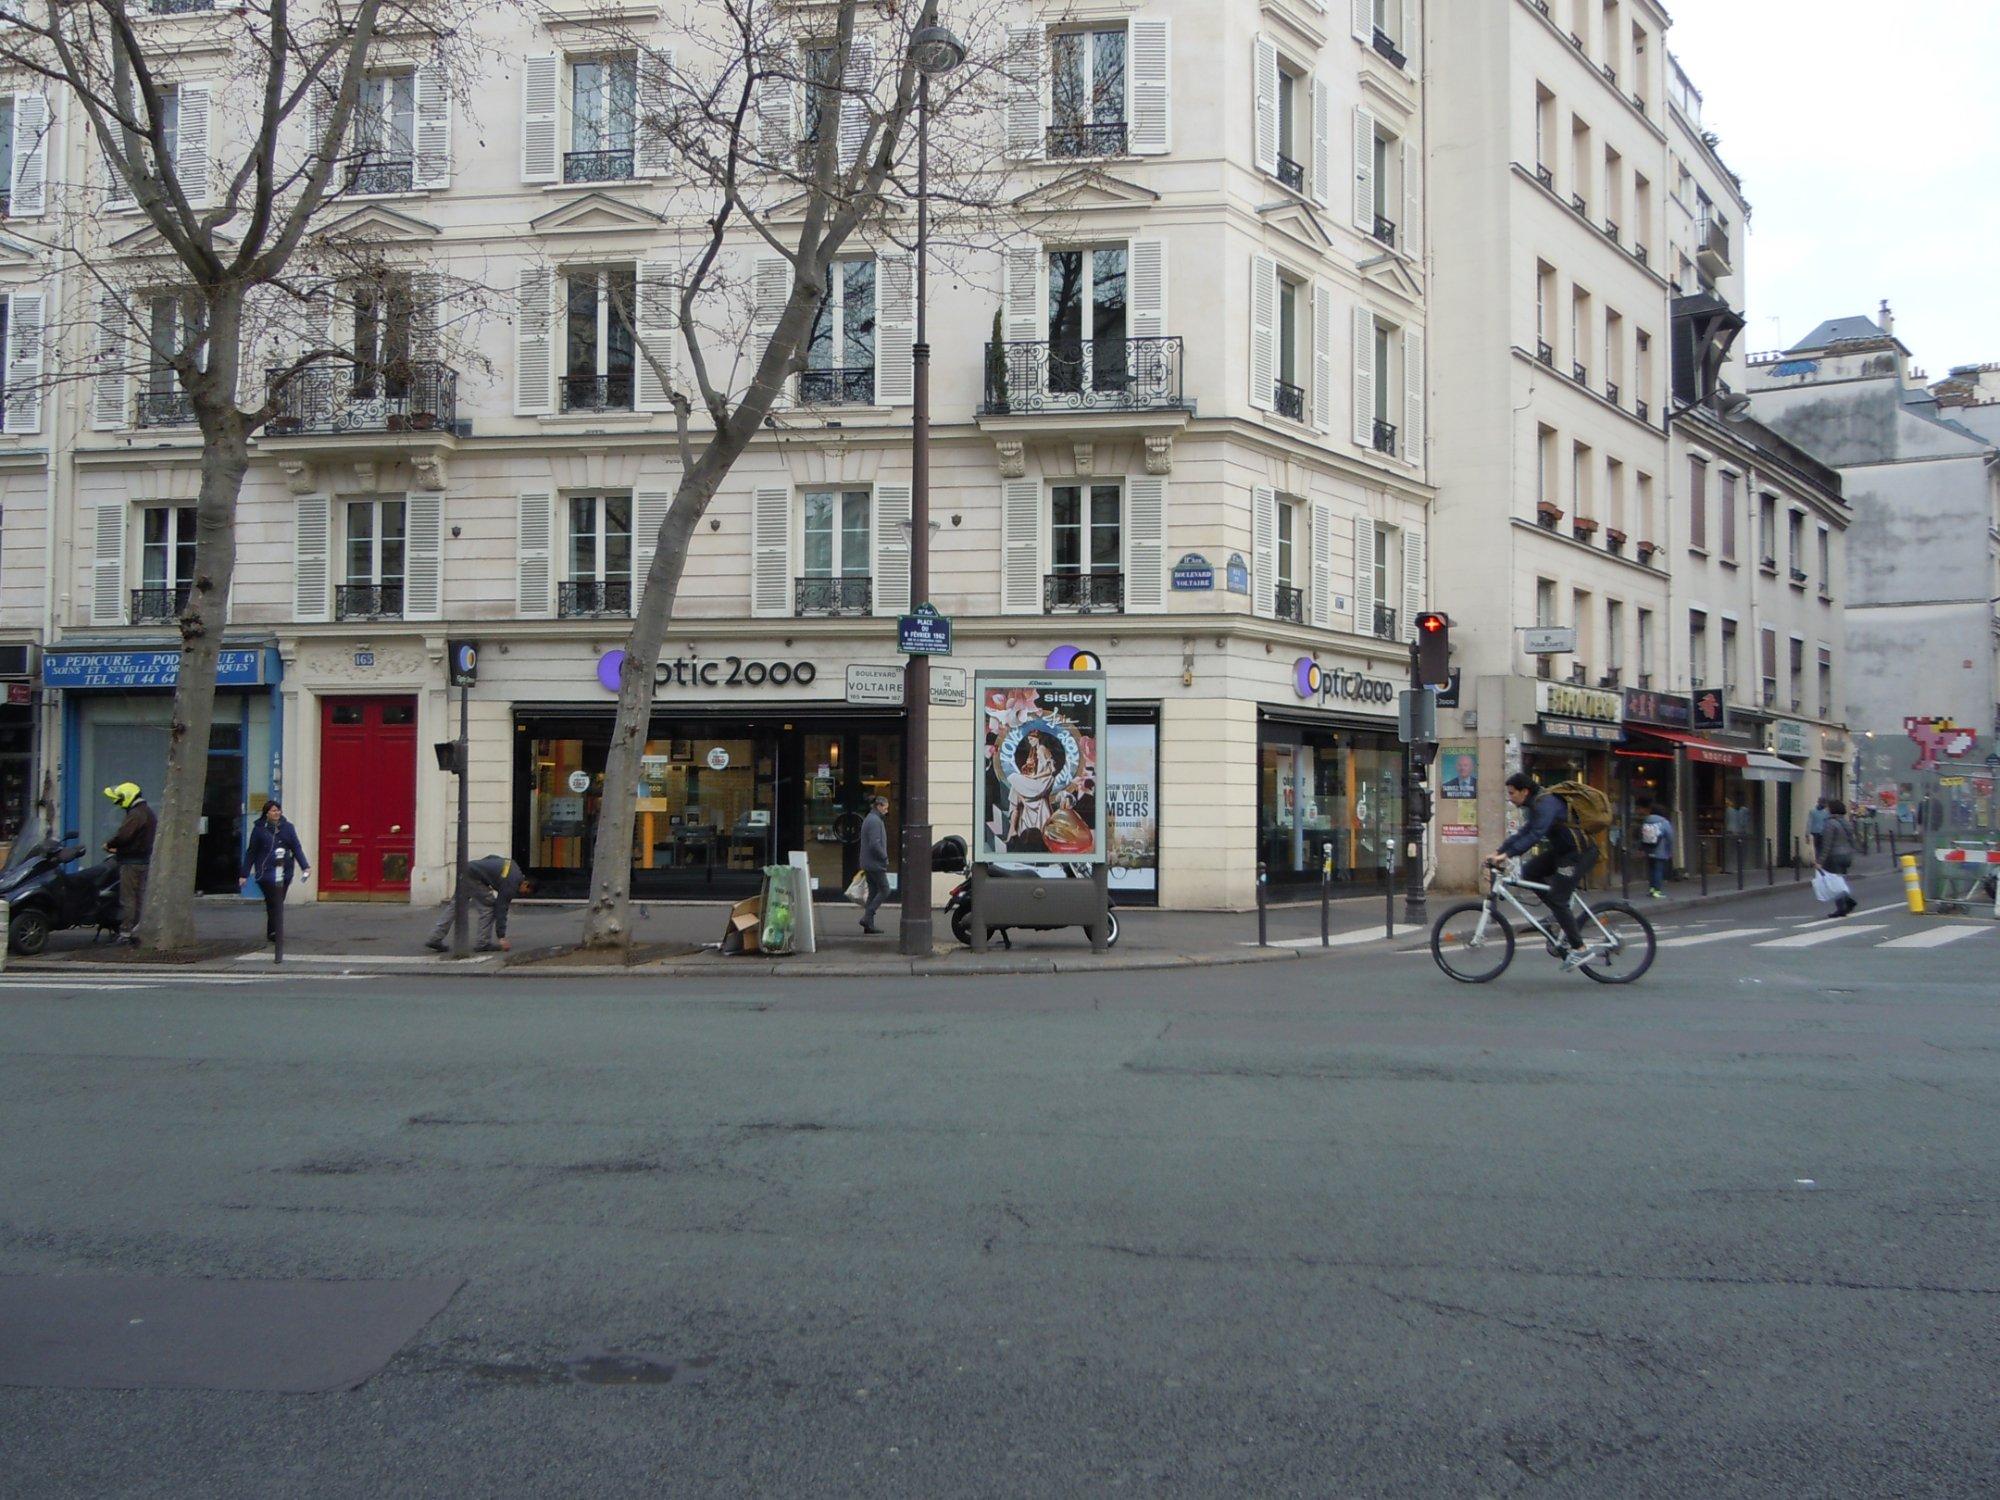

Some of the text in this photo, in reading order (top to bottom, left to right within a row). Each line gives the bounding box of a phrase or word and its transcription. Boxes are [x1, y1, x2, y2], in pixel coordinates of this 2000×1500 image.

[65, 655, 132, 667] PEDICURE
[356, 654, 373, 665] 165
[52, 667, 81, 675] SOINS
[87, 666, 101, 674] ET
[107, 665, 161, 673] SEMELLES
[725, 656, 816, 686] 2000
[855, 670, 897, 678] BOULEVARD
[85, 675, 109, 685] TEL
[140, 673, 155, 683] 44
[161, 672, 176, 683] 64
[848, 682, 904, 692] VOLTAIRE
[930, 687, 965, 698] CHARONNE
[1043, 691, 1092, 705] sisley
[1122, 790, 1149, 802] YOUR
[1106, 802, 1149, 817] MBERS
